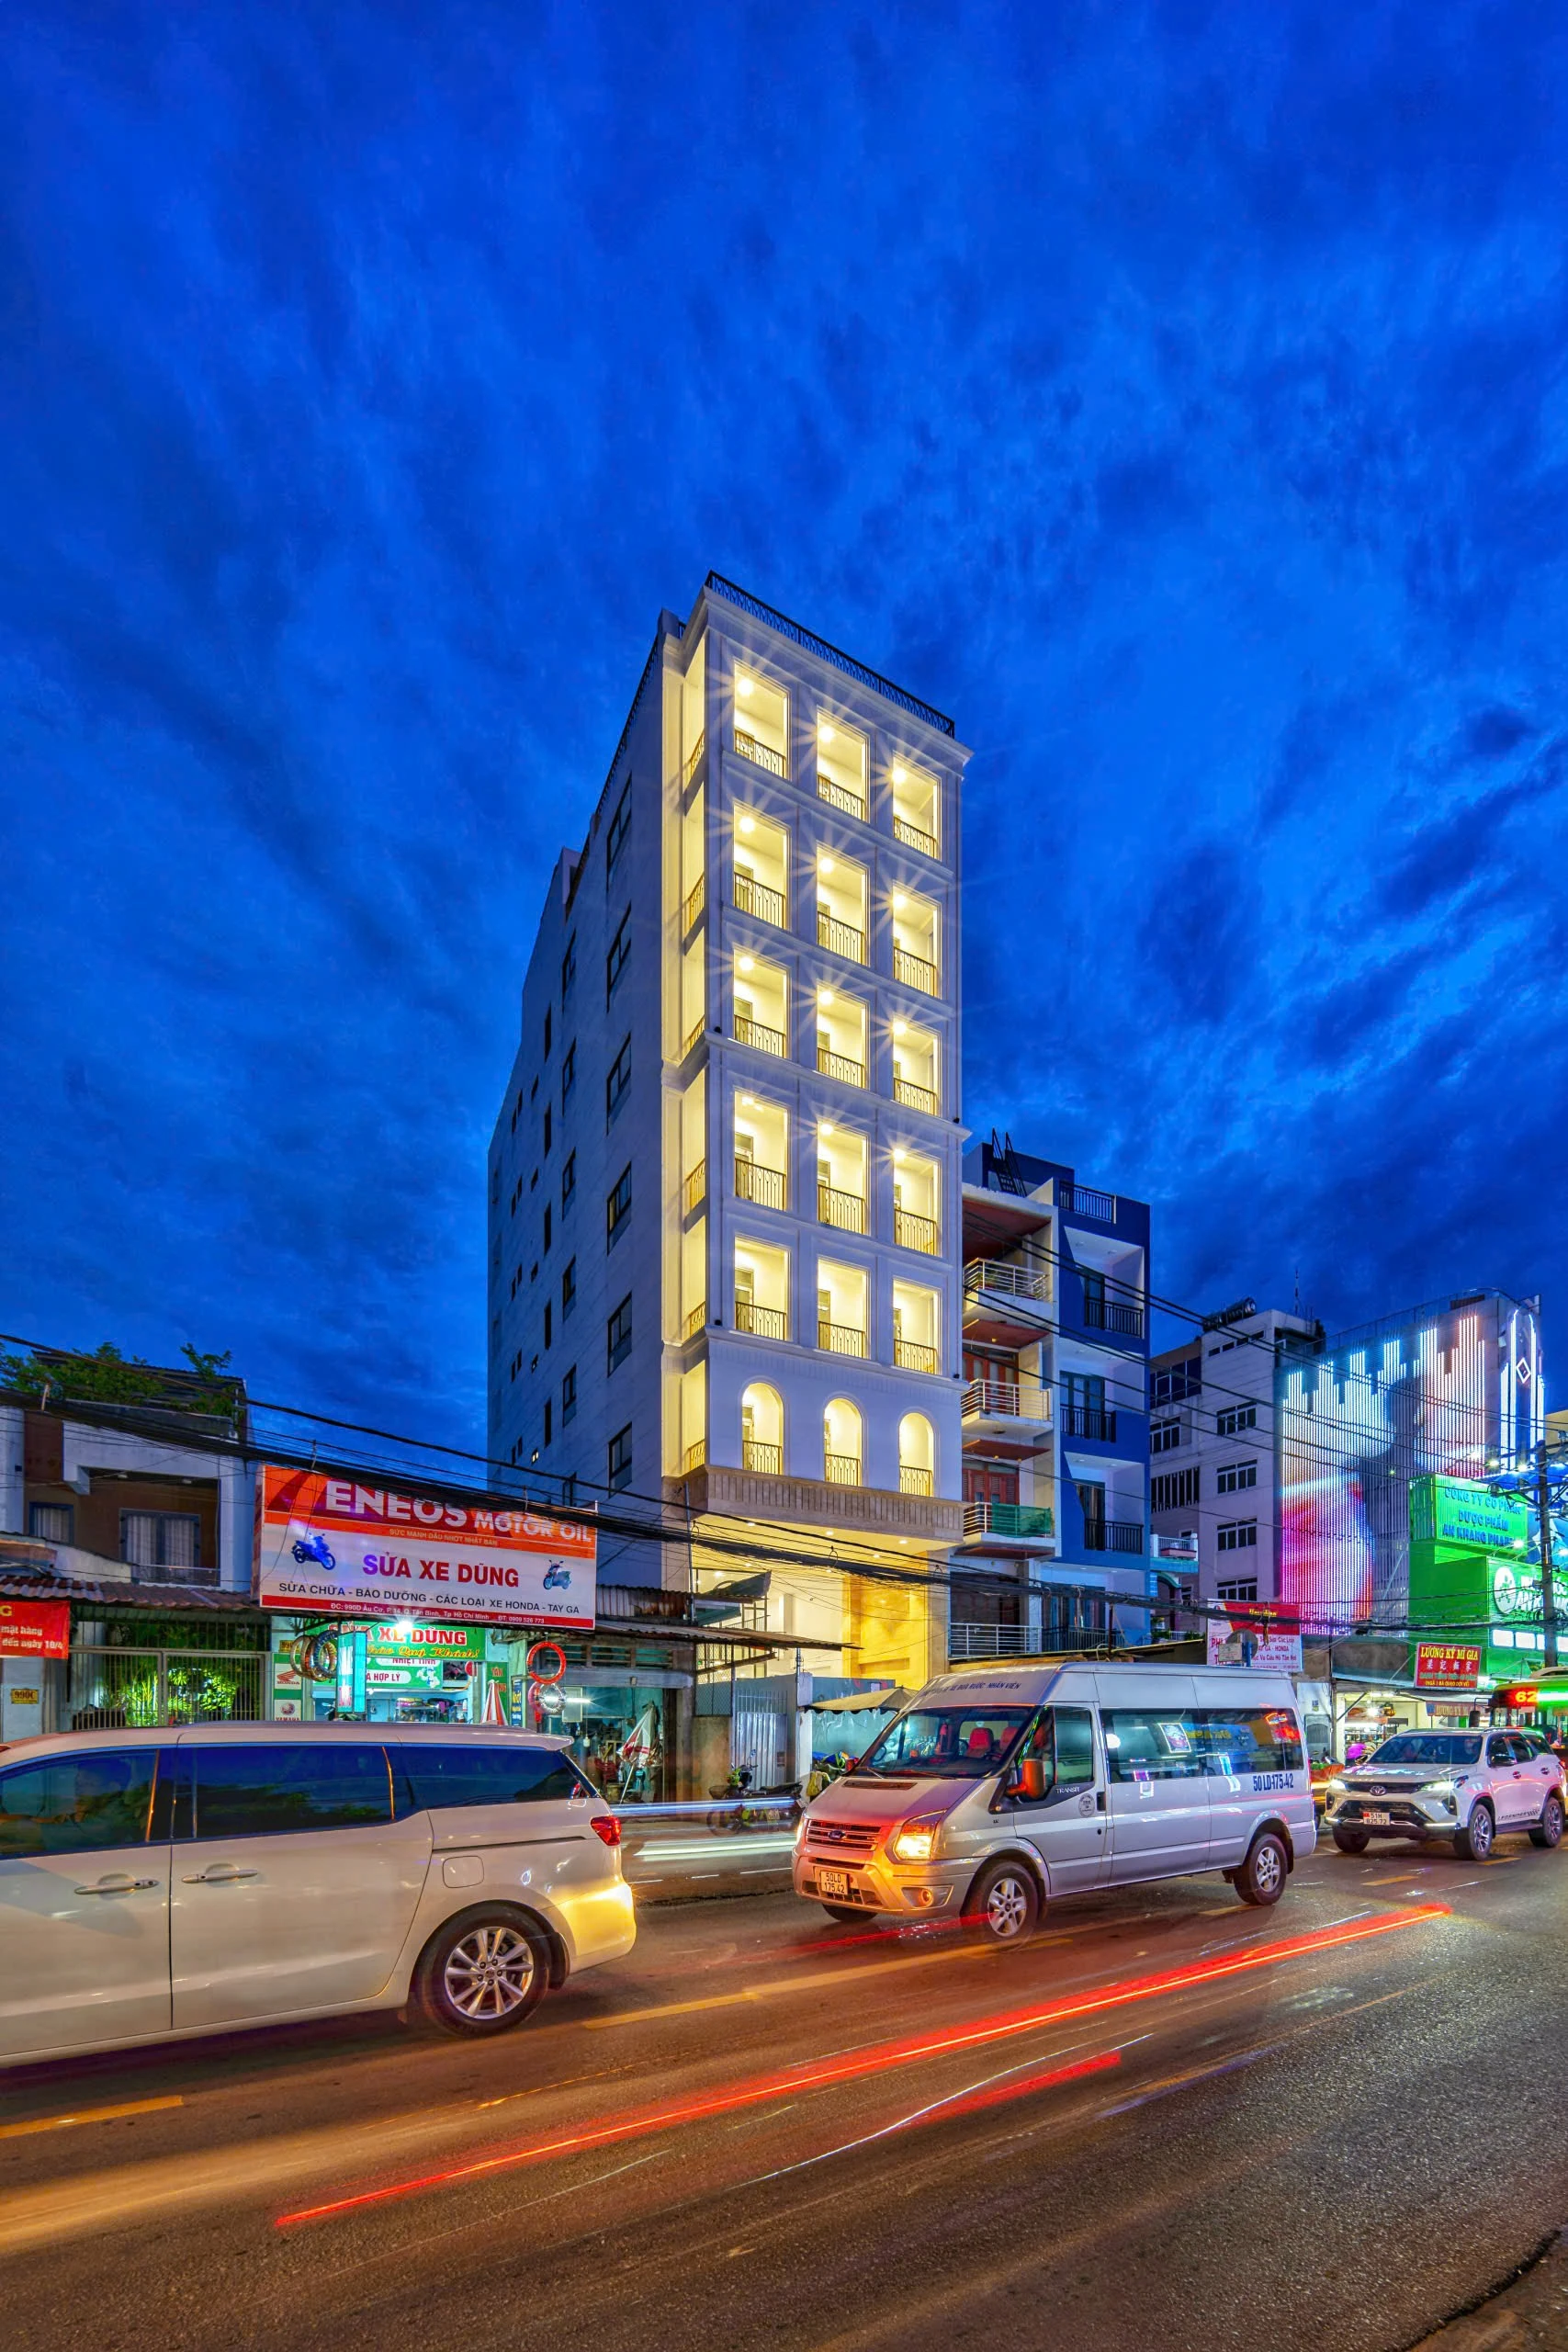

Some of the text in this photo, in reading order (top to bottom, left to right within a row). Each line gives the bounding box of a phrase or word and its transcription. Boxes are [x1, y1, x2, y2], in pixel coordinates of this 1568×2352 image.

[326, 1480, 592, 1543] ENEOS MOTOR OIL
[363, 1552, 519, 1588] SỬA XE DŨNG
[279, 1581, 580, 1614] SỬA CHỮA BẢO DƯỠNG CÁC LOẠI XE HONDA TAY GA
